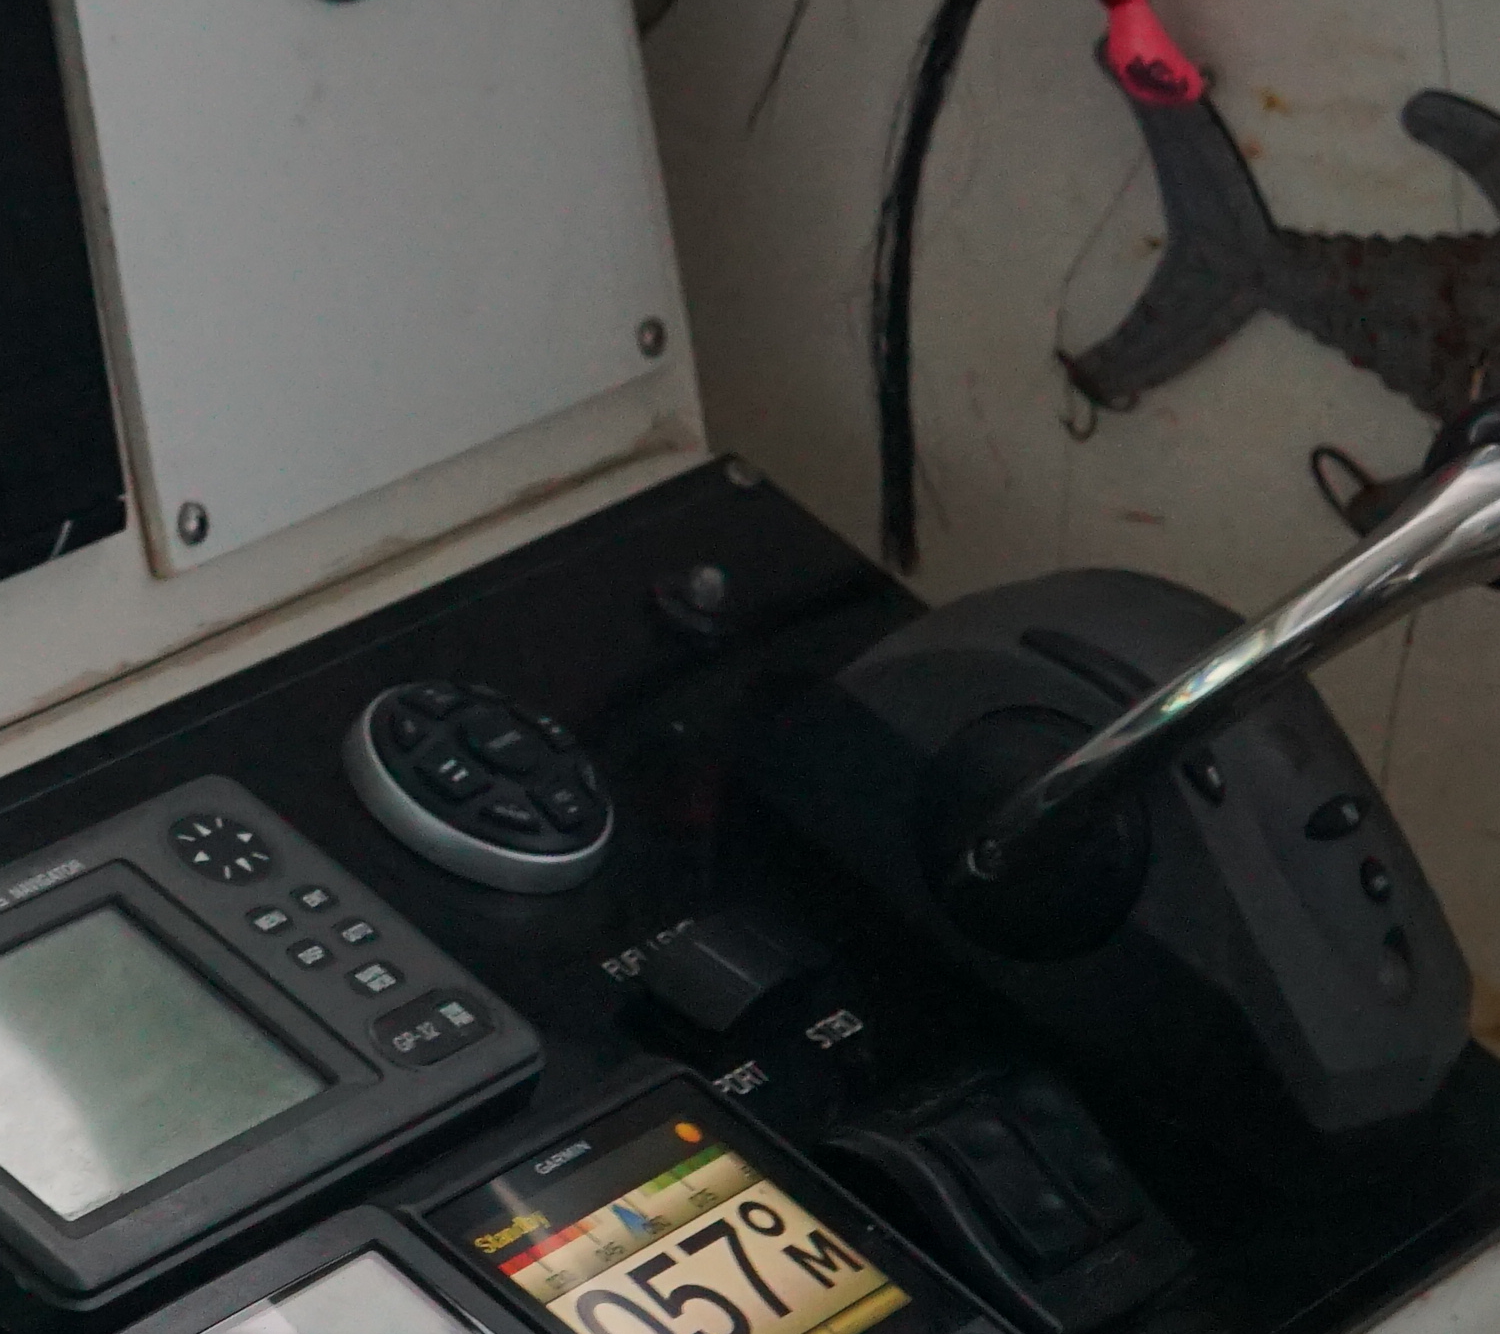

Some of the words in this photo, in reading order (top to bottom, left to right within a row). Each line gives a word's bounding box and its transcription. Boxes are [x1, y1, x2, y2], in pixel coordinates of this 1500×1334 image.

[9, 859, 85, 898] NAVIGATOR
[713, 1060, 769, 1095] PORT
[534, 1140, 592, 1175] GARMIN
[474, 1211, 551, 1254] Standby
[781, 1229, 864, 1288] M
